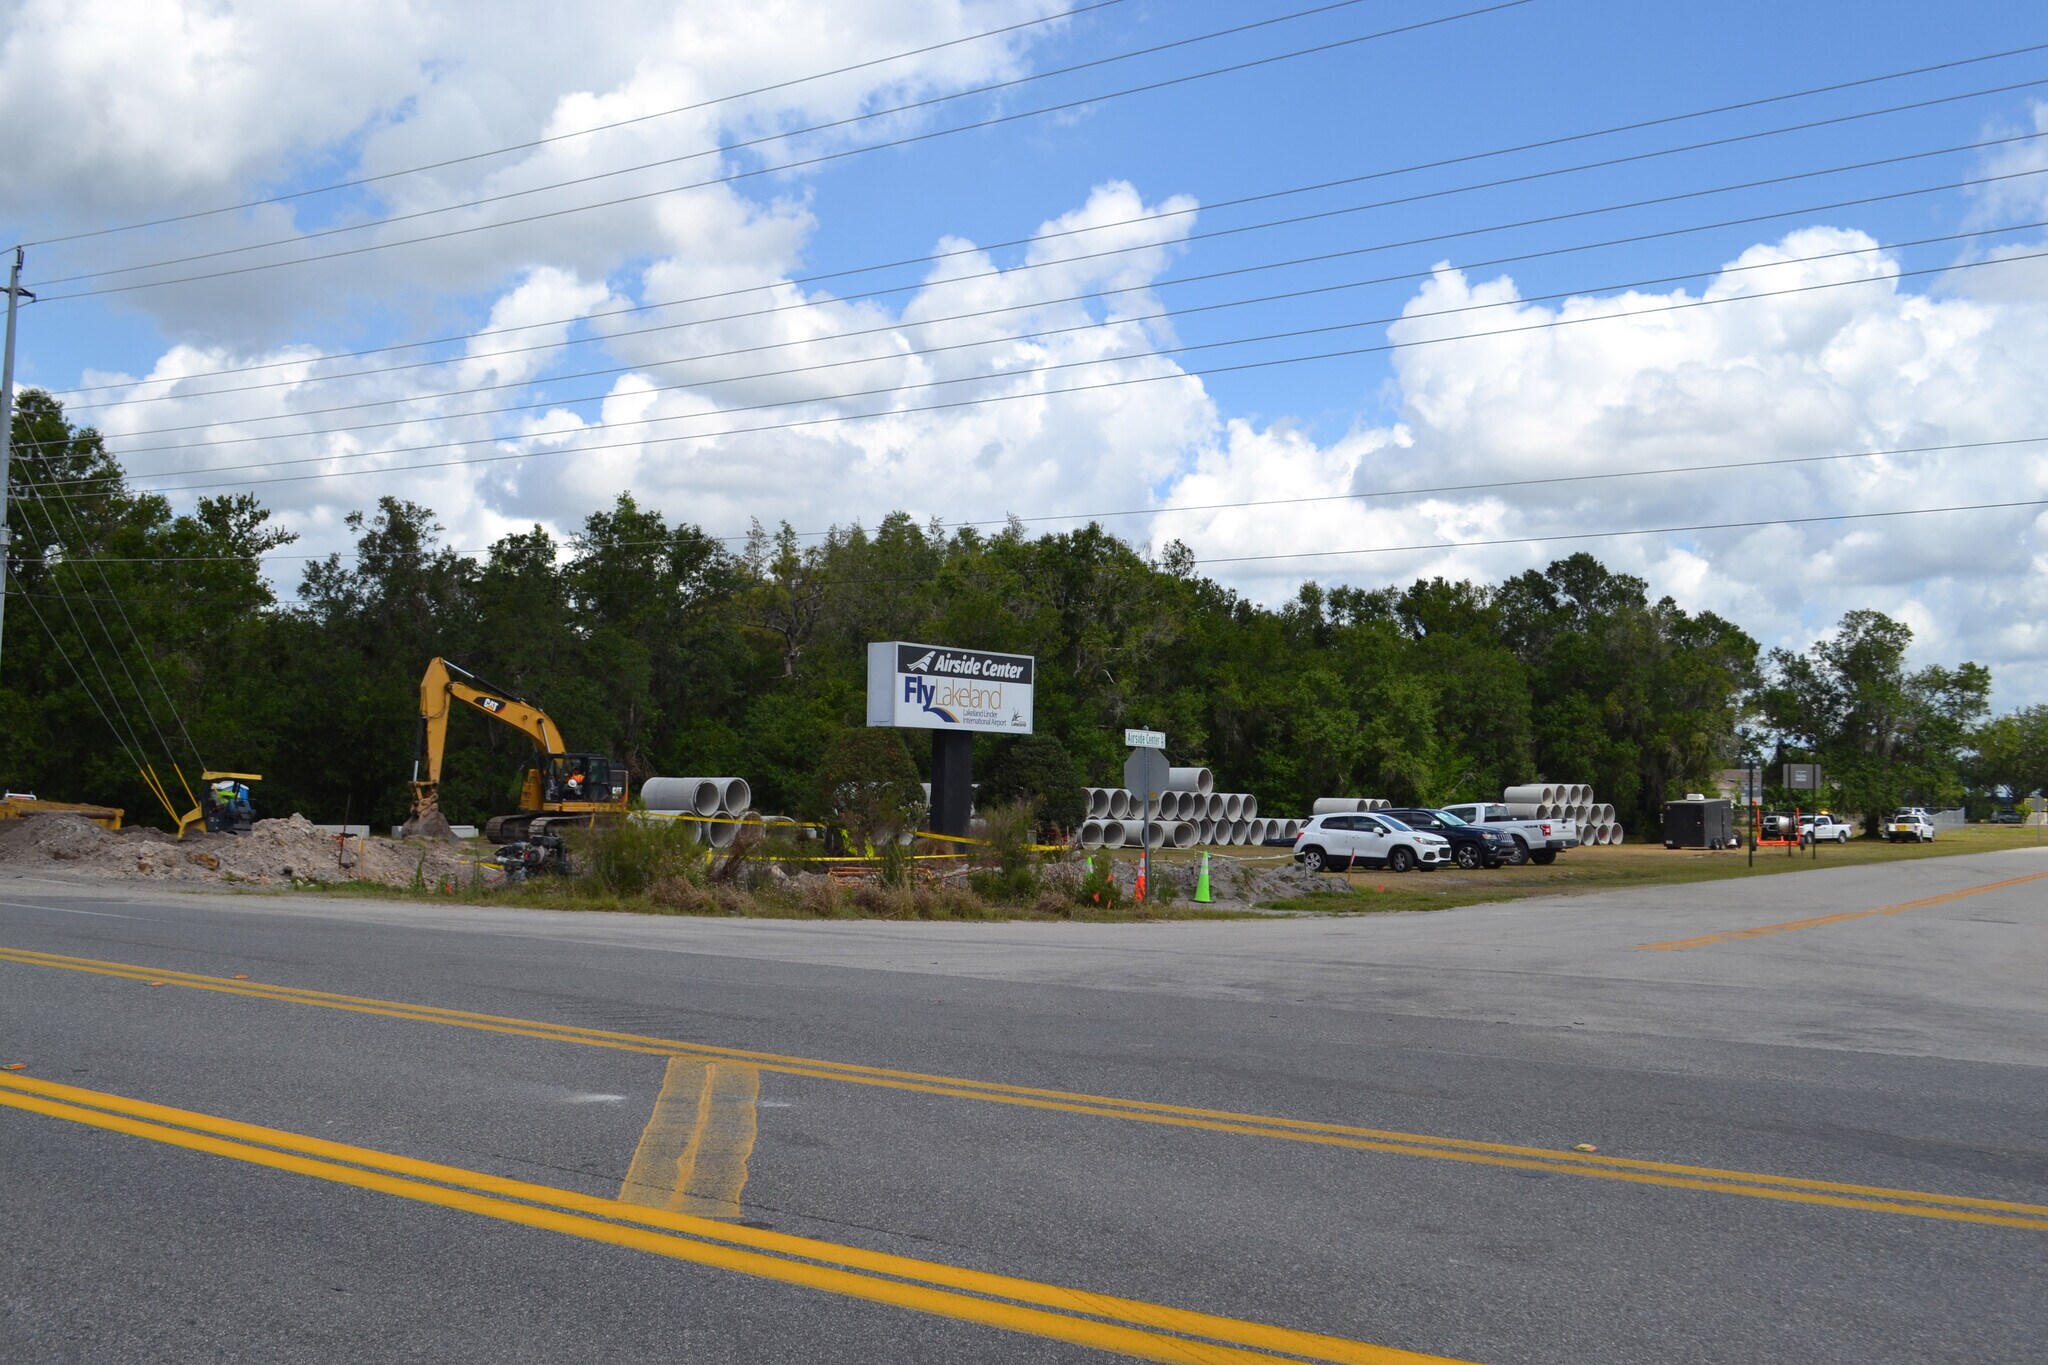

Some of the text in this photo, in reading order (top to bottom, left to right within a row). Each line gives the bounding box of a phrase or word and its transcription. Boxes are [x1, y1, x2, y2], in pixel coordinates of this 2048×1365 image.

[934, 653, 1024, 679] Airside Center
[484, 698, 499, 712] CAT
[962, 709, 998, 719] Lakeland Linder
[962, 717, 1007, 727] International Airport
[1128, 732, 1145, 745] Airside
[1146, 734, 1160, 746] Center
[611, 786, 623, 795] CAT
